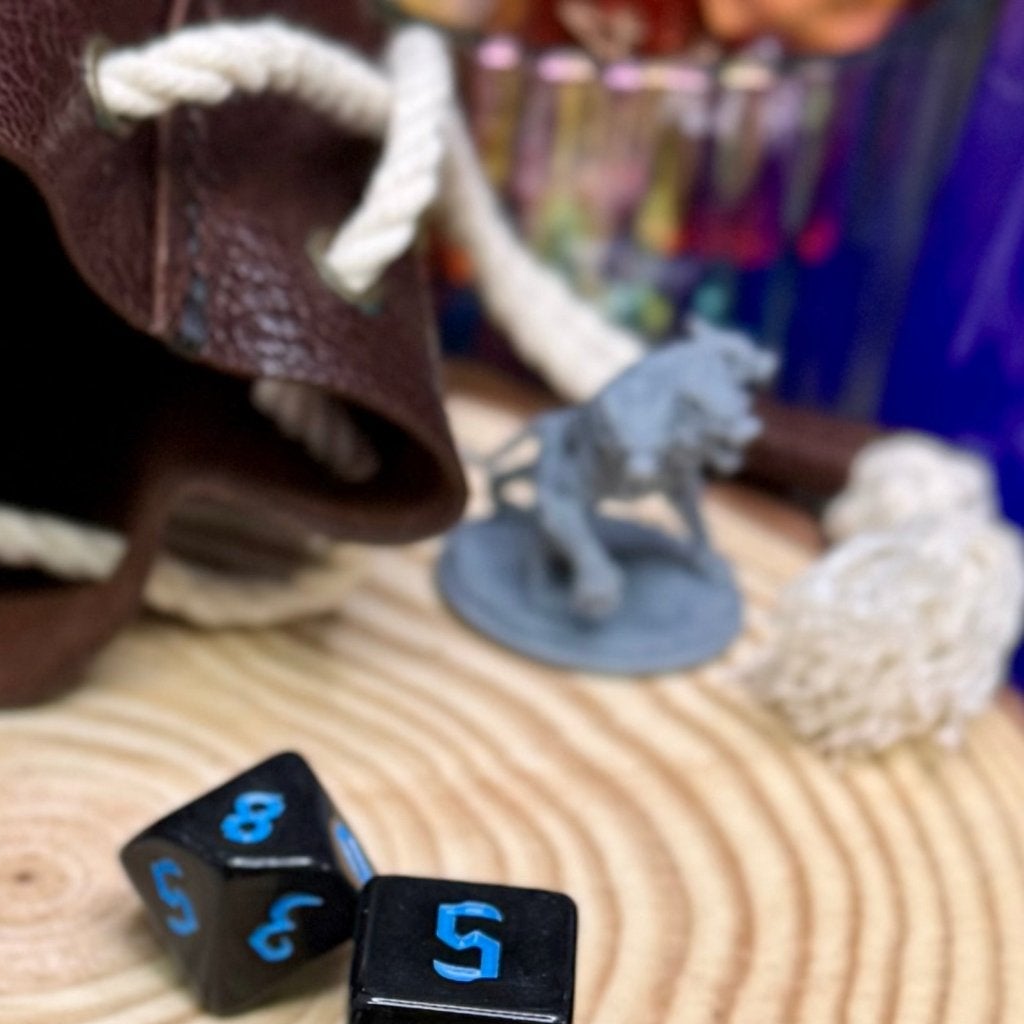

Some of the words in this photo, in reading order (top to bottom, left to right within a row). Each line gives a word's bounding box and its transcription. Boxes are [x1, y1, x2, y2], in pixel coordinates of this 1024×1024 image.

[219, 790, 287, 845] 8
[150, 857, 197, 936] 5
[248, 894, 323, 962] 3
[432, 900, 504, 983] 5
